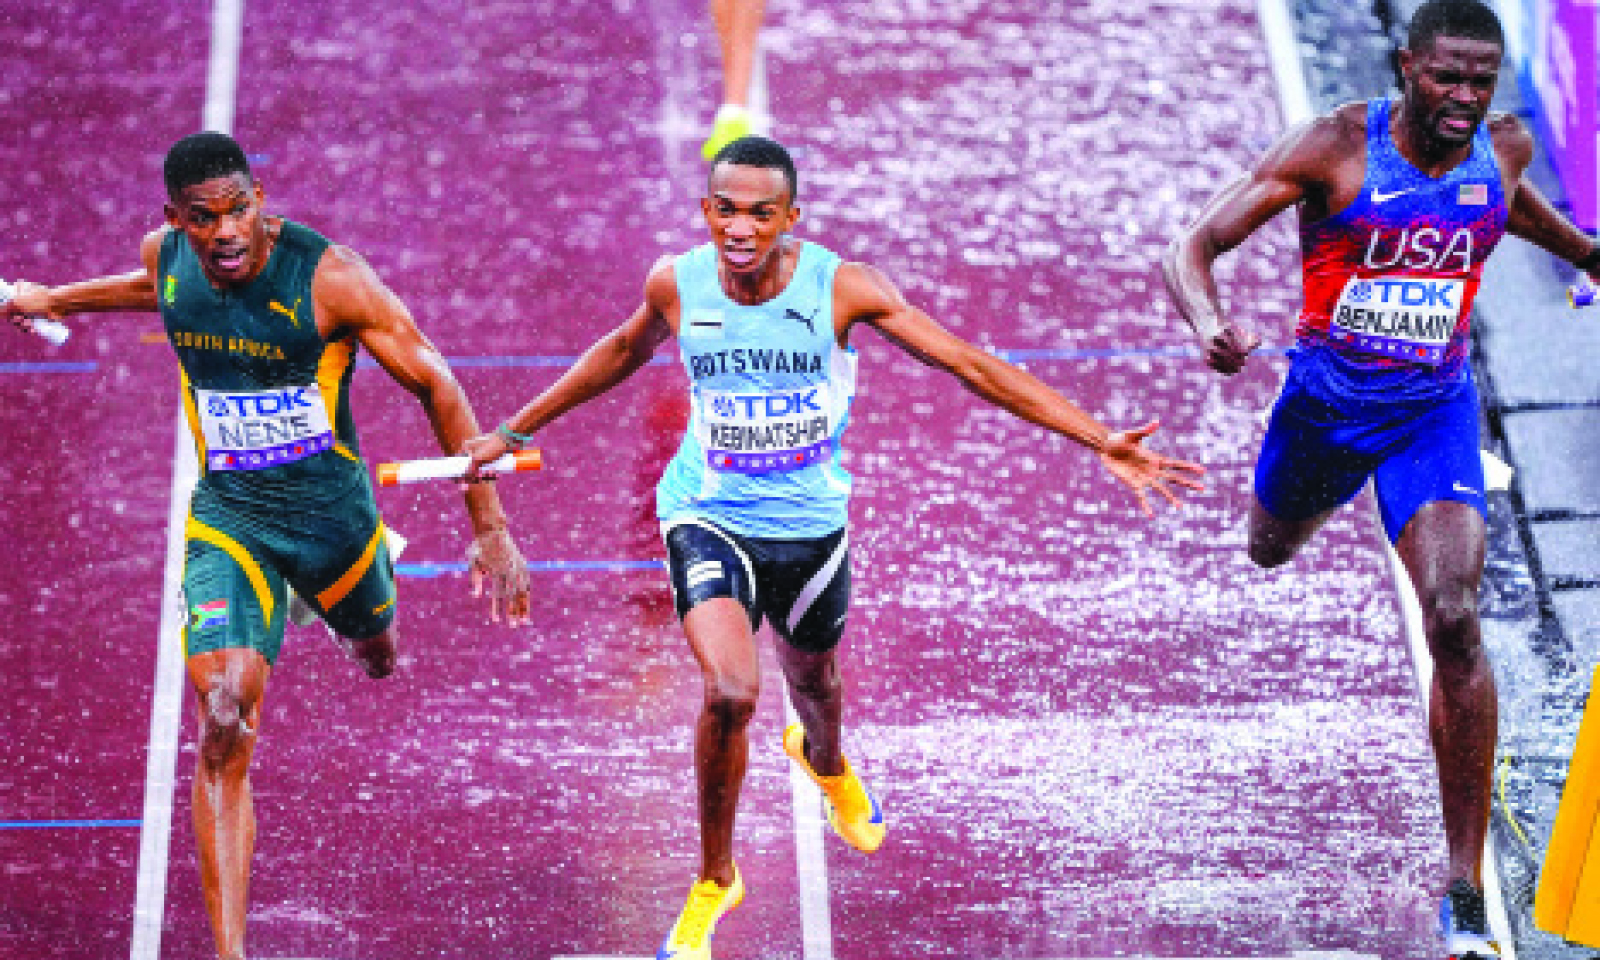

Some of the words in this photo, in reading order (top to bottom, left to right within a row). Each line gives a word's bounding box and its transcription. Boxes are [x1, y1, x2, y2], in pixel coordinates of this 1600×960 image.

[1363, 227, 1474, 272] USA
[1374, 281, 1454, 309] TDK
[1336, 305, 1454, 340] BENJAMIN
[174, 331, 223, 350] SOUTH
[228, 336, 286, 360] AFRICA
[690, 349, 822, 379] BOTSWANA
[227, 388, 312, 417] TDK
[735, 389, 821, 419] TDK
[218, 413, 313, 447] NENE
